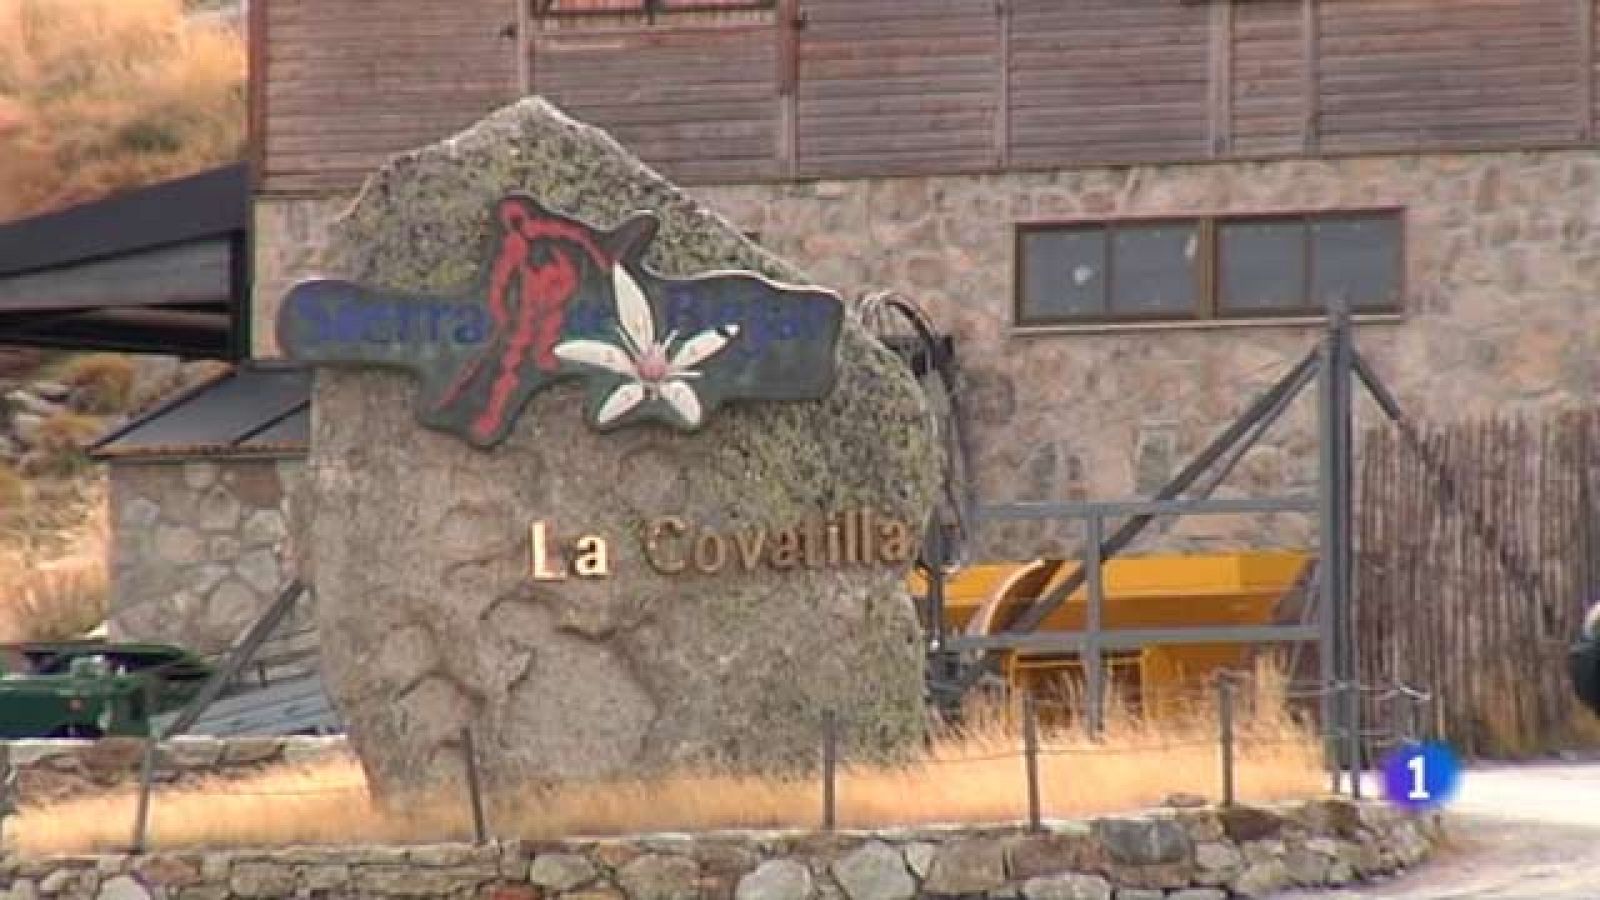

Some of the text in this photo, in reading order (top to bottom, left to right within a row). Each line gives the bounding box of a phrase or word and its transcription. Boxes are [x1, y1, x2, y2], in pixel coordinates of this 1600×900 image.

[292, 285, 484, 343] Sierra
[530, 510, 911, 580] La Covatilla
